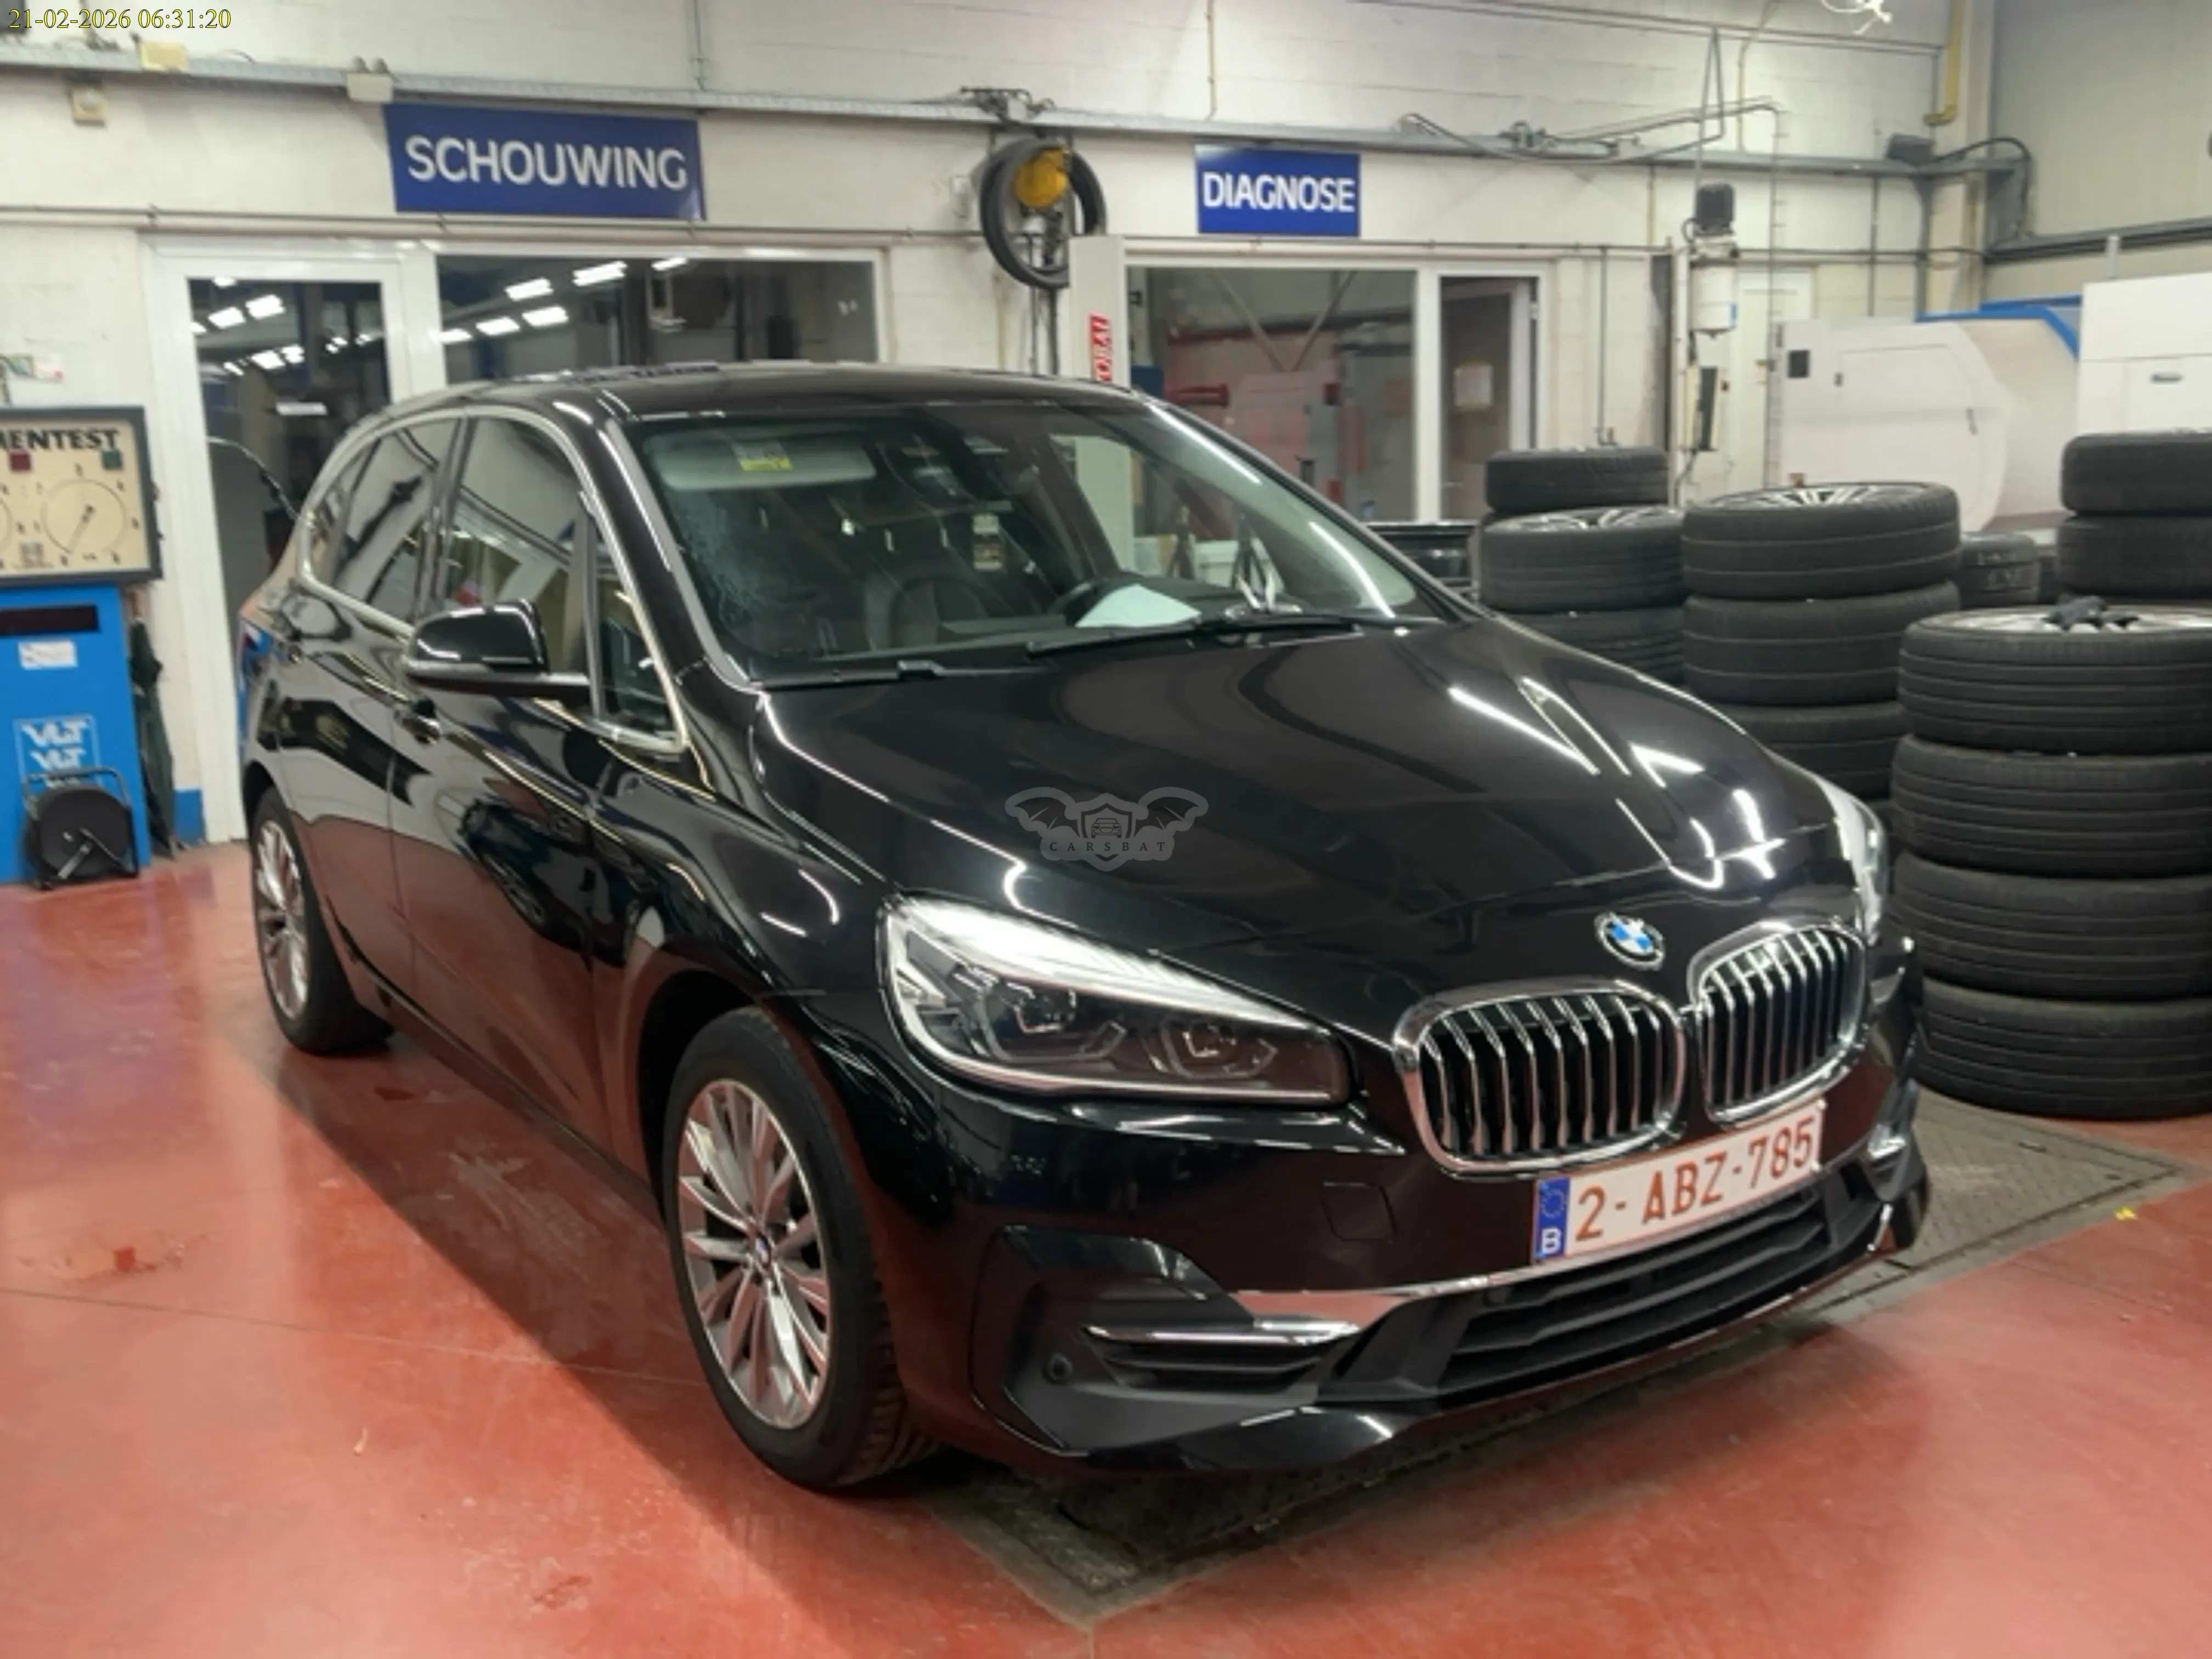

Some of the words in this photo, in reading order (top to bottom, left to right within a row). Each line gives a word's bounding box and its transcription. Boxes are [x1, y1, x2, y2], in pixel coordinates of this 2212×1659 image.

[404, 135, 689, 191] SCHOUWING
[1203, 171, 1356, 213] DIAGNOSE
[1575, 1116, 1814, 1242] 2-ABZ-785
[1541, 1227, 1562, 1254] B
